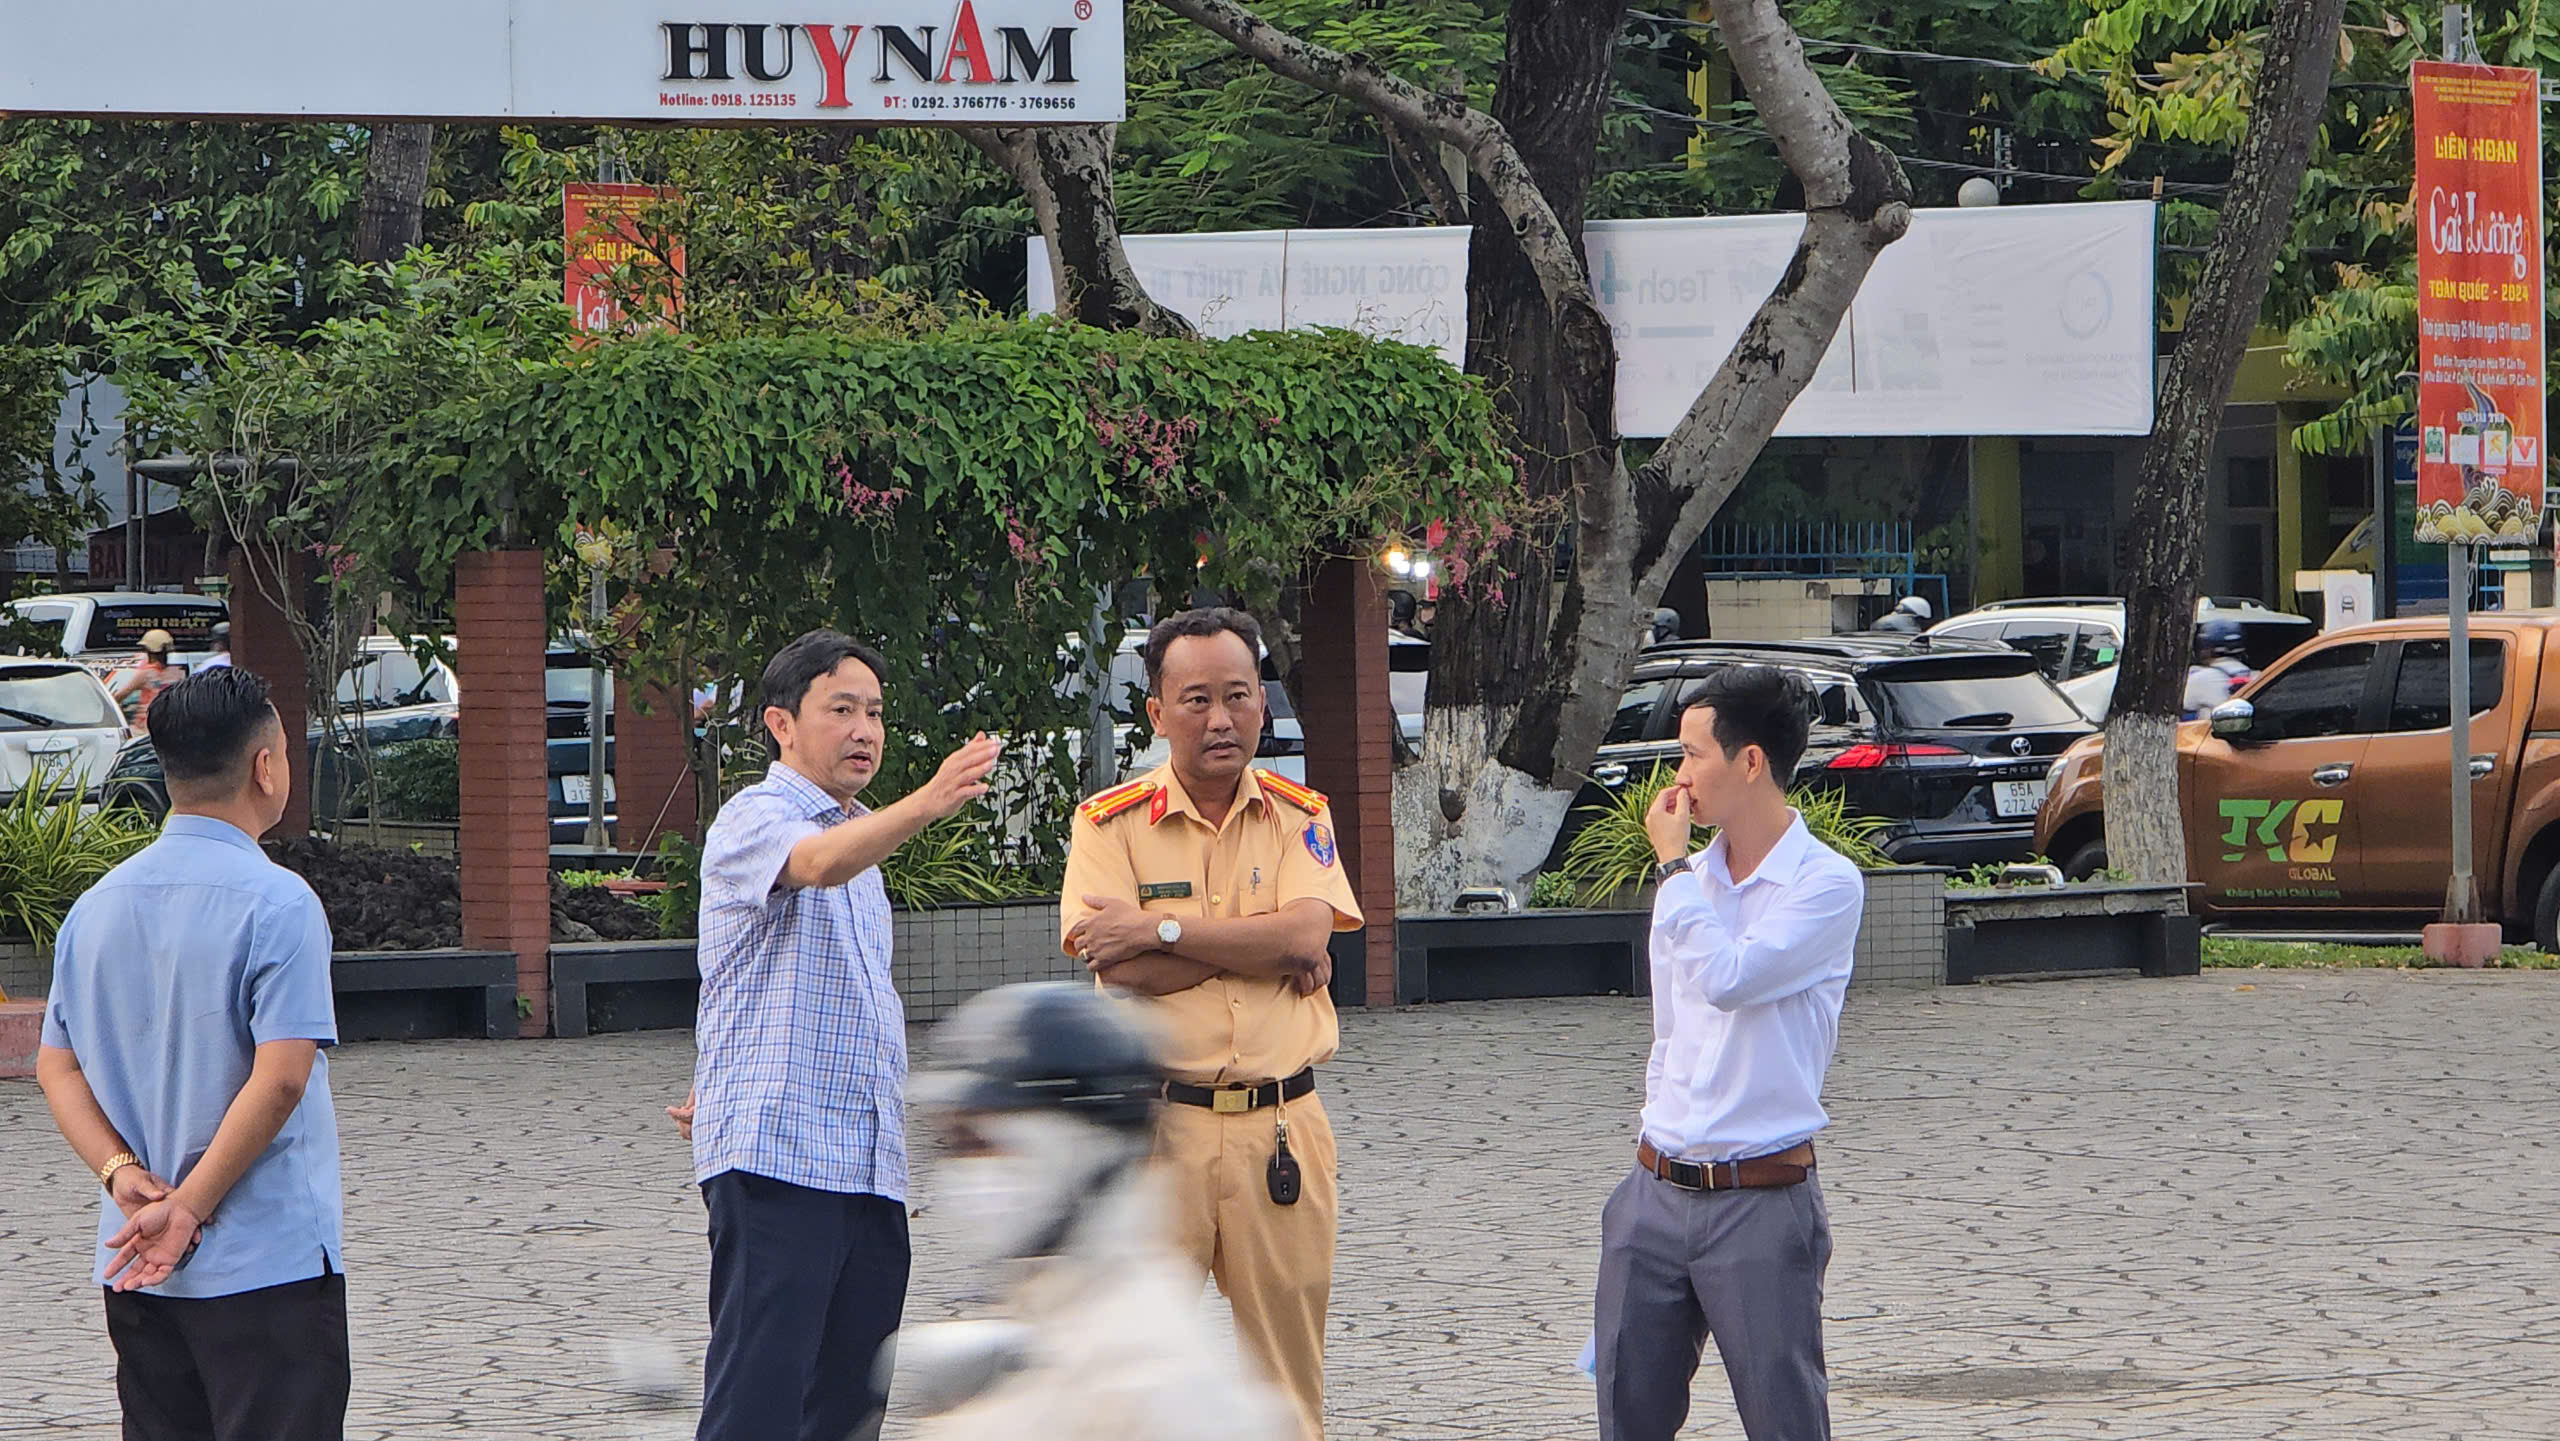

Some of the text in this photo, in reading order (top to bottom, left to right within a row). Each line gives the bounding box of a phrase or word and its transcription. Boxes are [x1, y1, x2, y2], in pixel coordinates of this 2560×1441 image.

[659, 92, 708, 106] Hotline:
[883, 95, 907, 109] ĐT:
[1019, 96, 1076, 110] 3769656
[2435, 131, 2518, 164] LIÊN HOAN
[2430, 186, 2463, 255] Cải
[2429, 278, 2457, 299] TOÀN
[2459, 278, 2489, 303] QUỐC
[2501, 283, 2529, 302] 2024
[2010, 783, 2033, 797] 65A
[2288, 867, 2336, 881] GLOBAL
